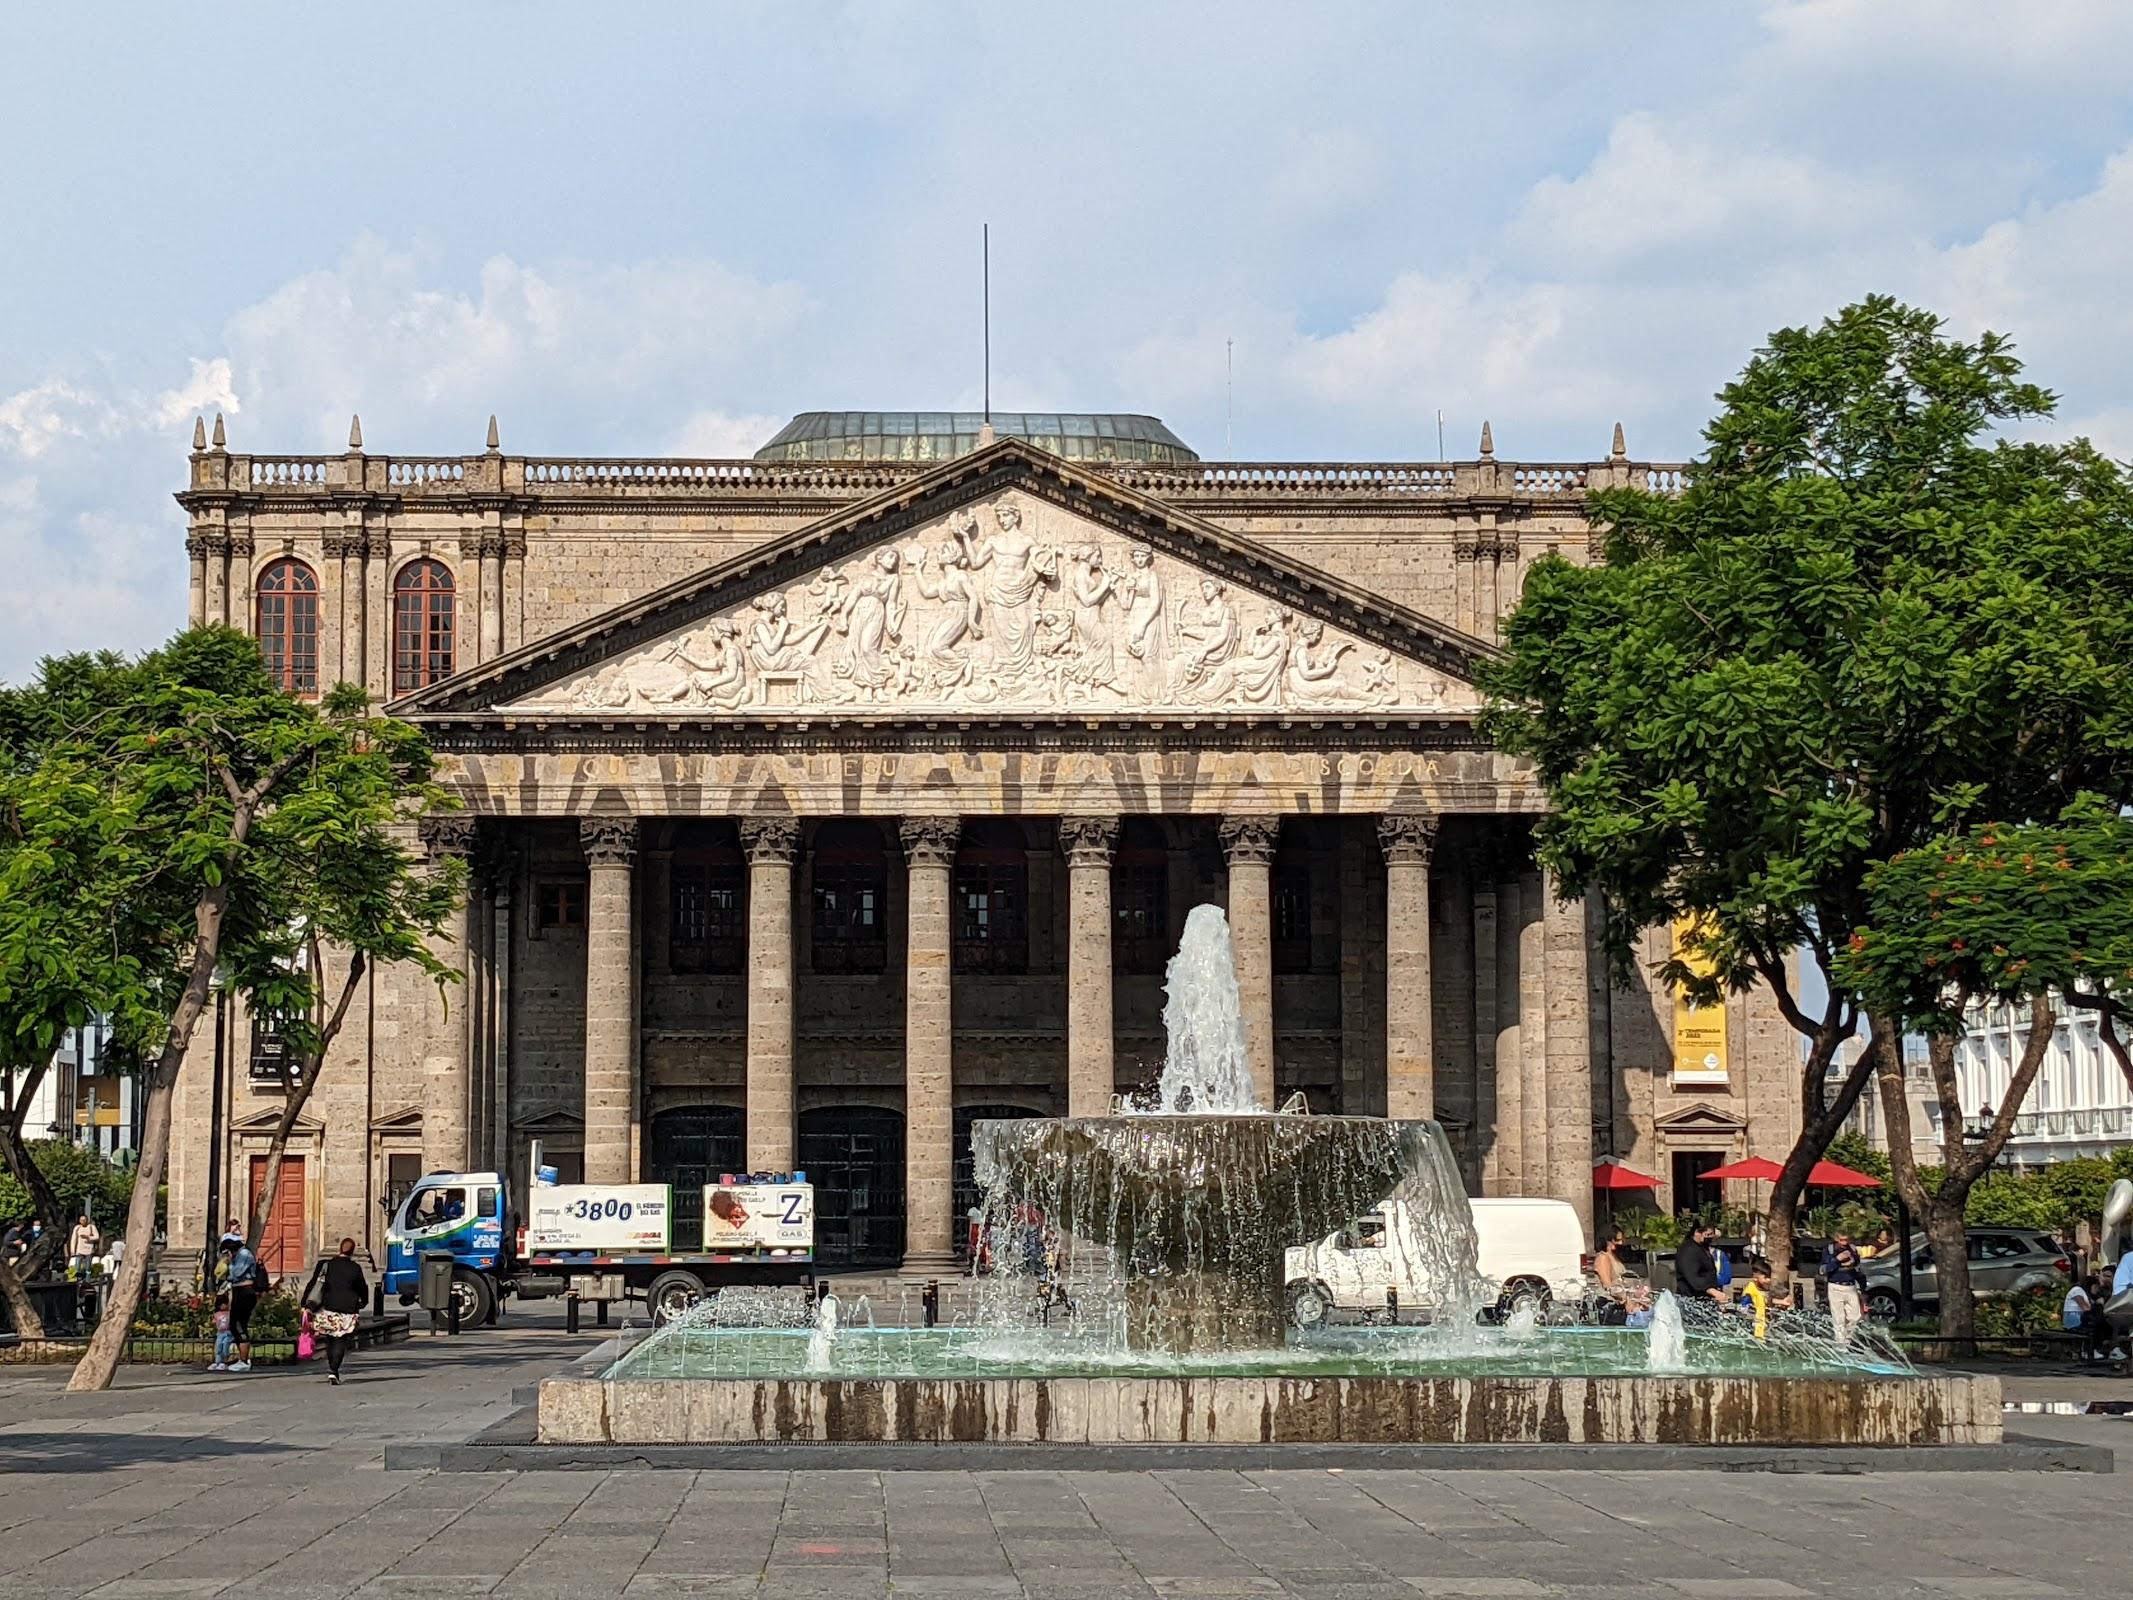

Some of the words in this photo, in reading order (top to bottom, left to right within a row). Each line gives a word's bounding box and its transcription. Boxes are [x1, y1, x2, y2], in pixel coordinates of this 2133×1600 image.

[582, 757, 639, 778] QUE
[1287, 757, 1440, 777] DISCORDIA
[781, 1194, 802, 1224] Z
